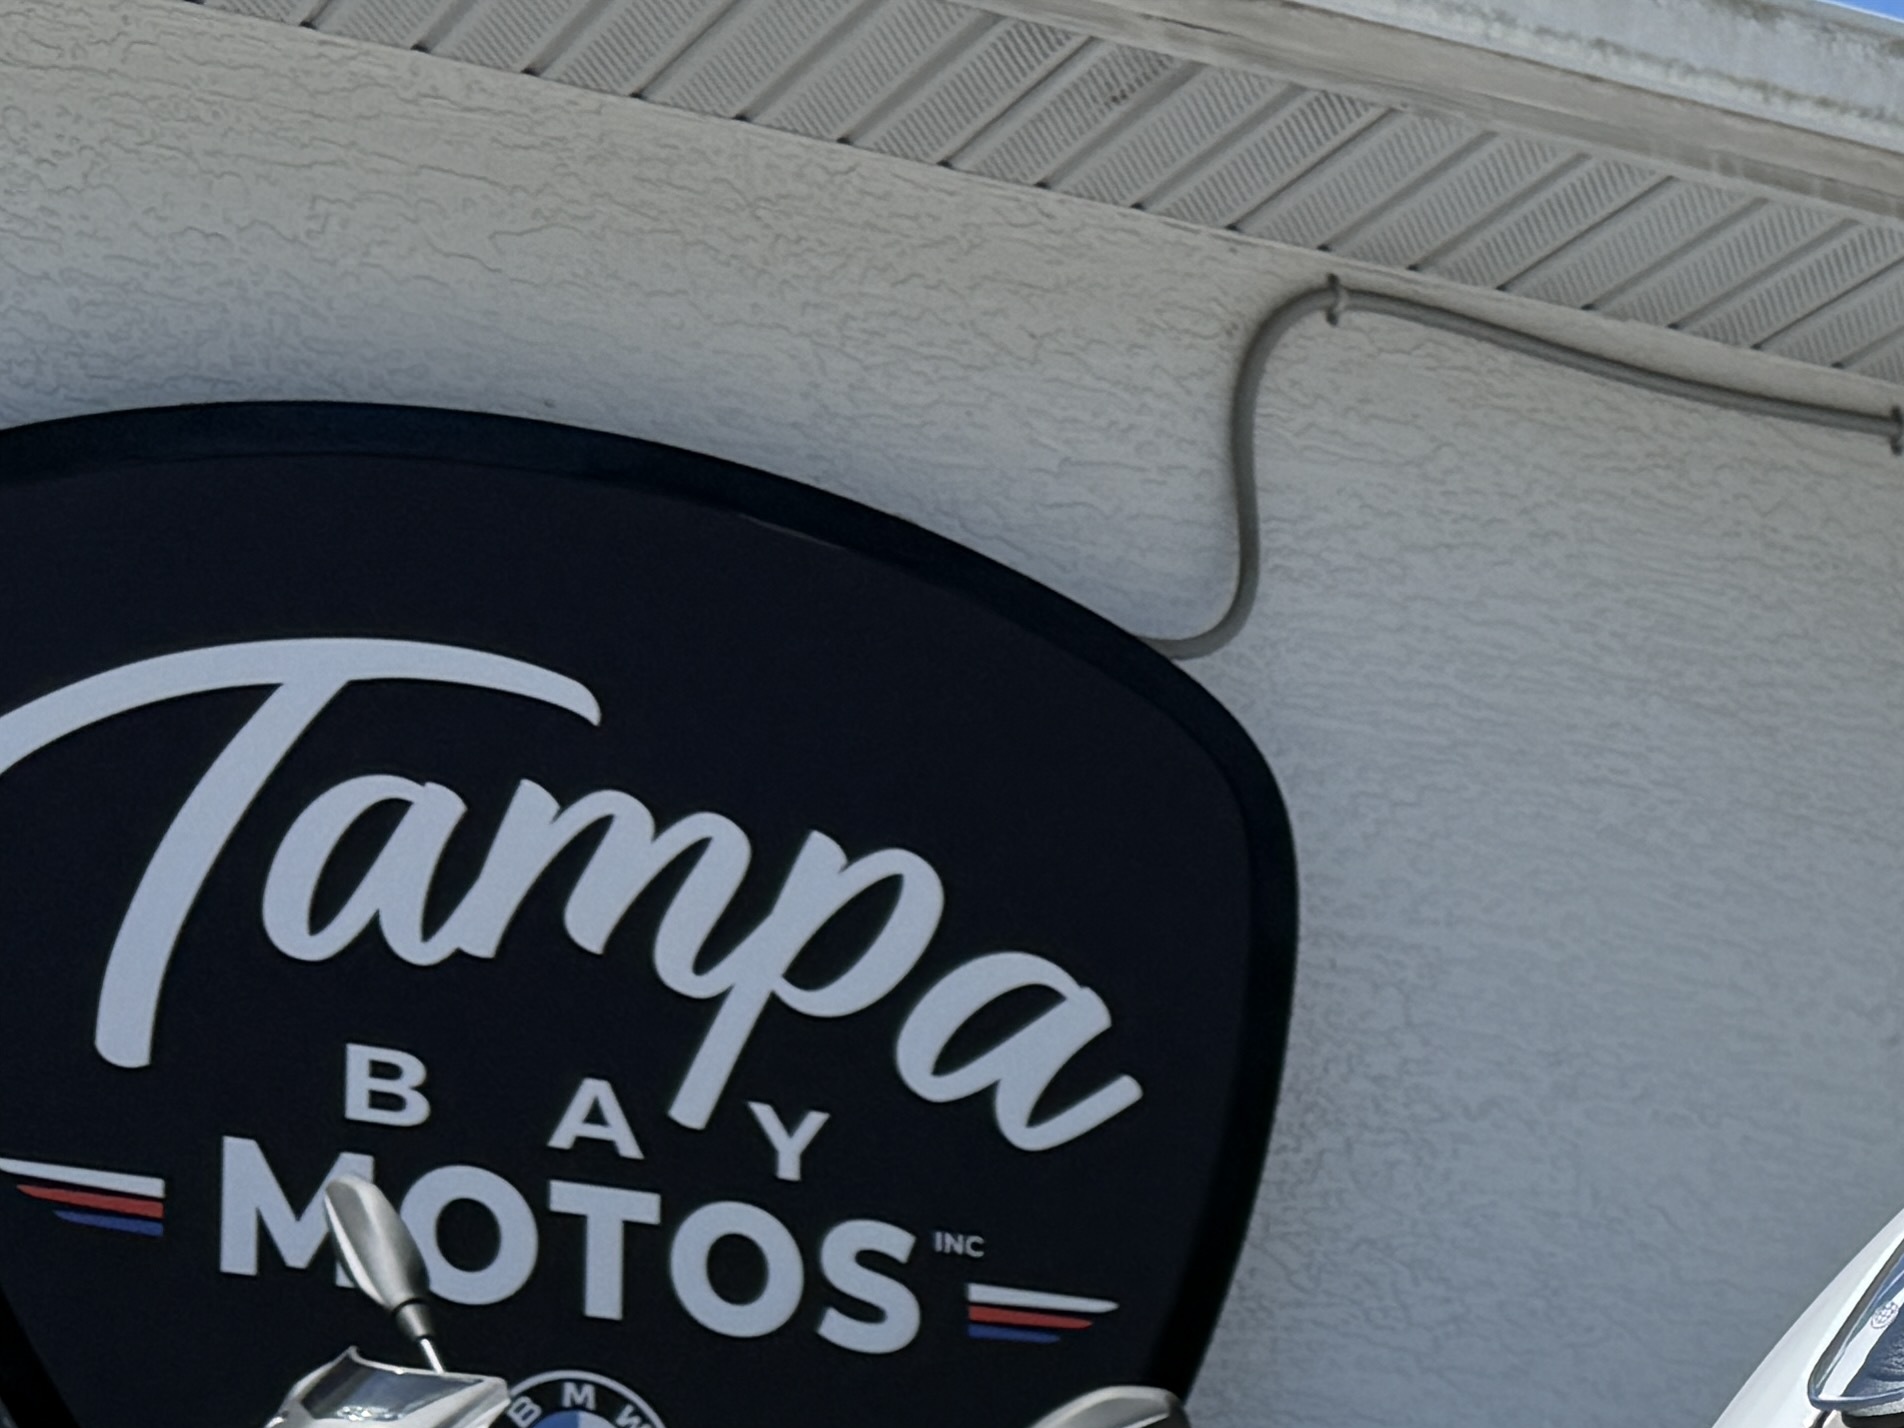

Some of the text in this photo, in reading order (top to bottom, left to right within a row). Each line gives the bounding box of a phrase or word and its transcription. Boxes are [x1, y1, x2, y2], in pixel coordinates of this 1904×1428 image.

[0, 637, 1142, 1151] Tampa
[345, 1043, 829, 1181] BAY
[219, 1136, 921, 1354] MOTOS
[932, 1230, 985, 1258] INC
